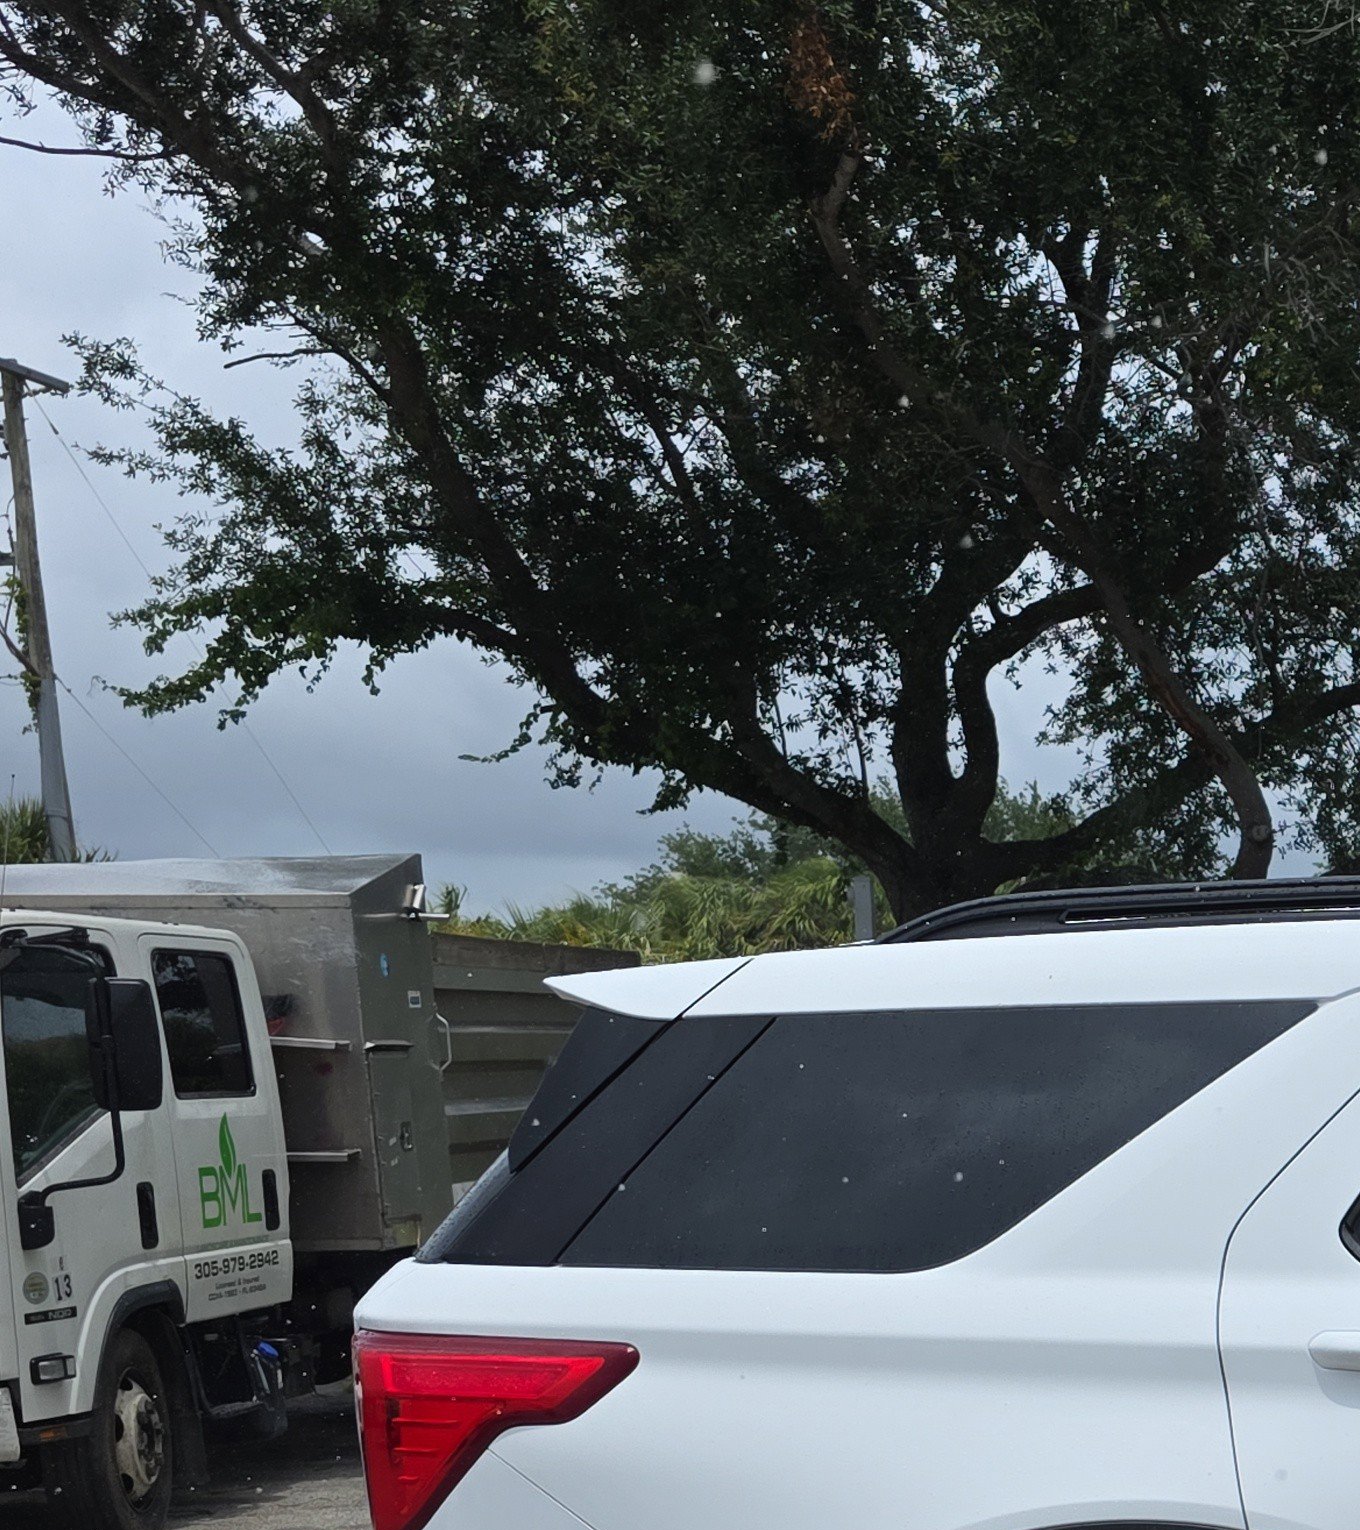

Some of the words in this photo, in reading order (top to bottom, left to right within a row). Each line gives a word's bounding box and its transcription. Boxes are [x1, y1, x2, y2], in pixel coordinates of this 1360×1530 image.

[197, 1163, 263, 1229] BML
[194, 1249, 280, 1280] 305-979-2942
[54, 1273, 73, 1302] 13
